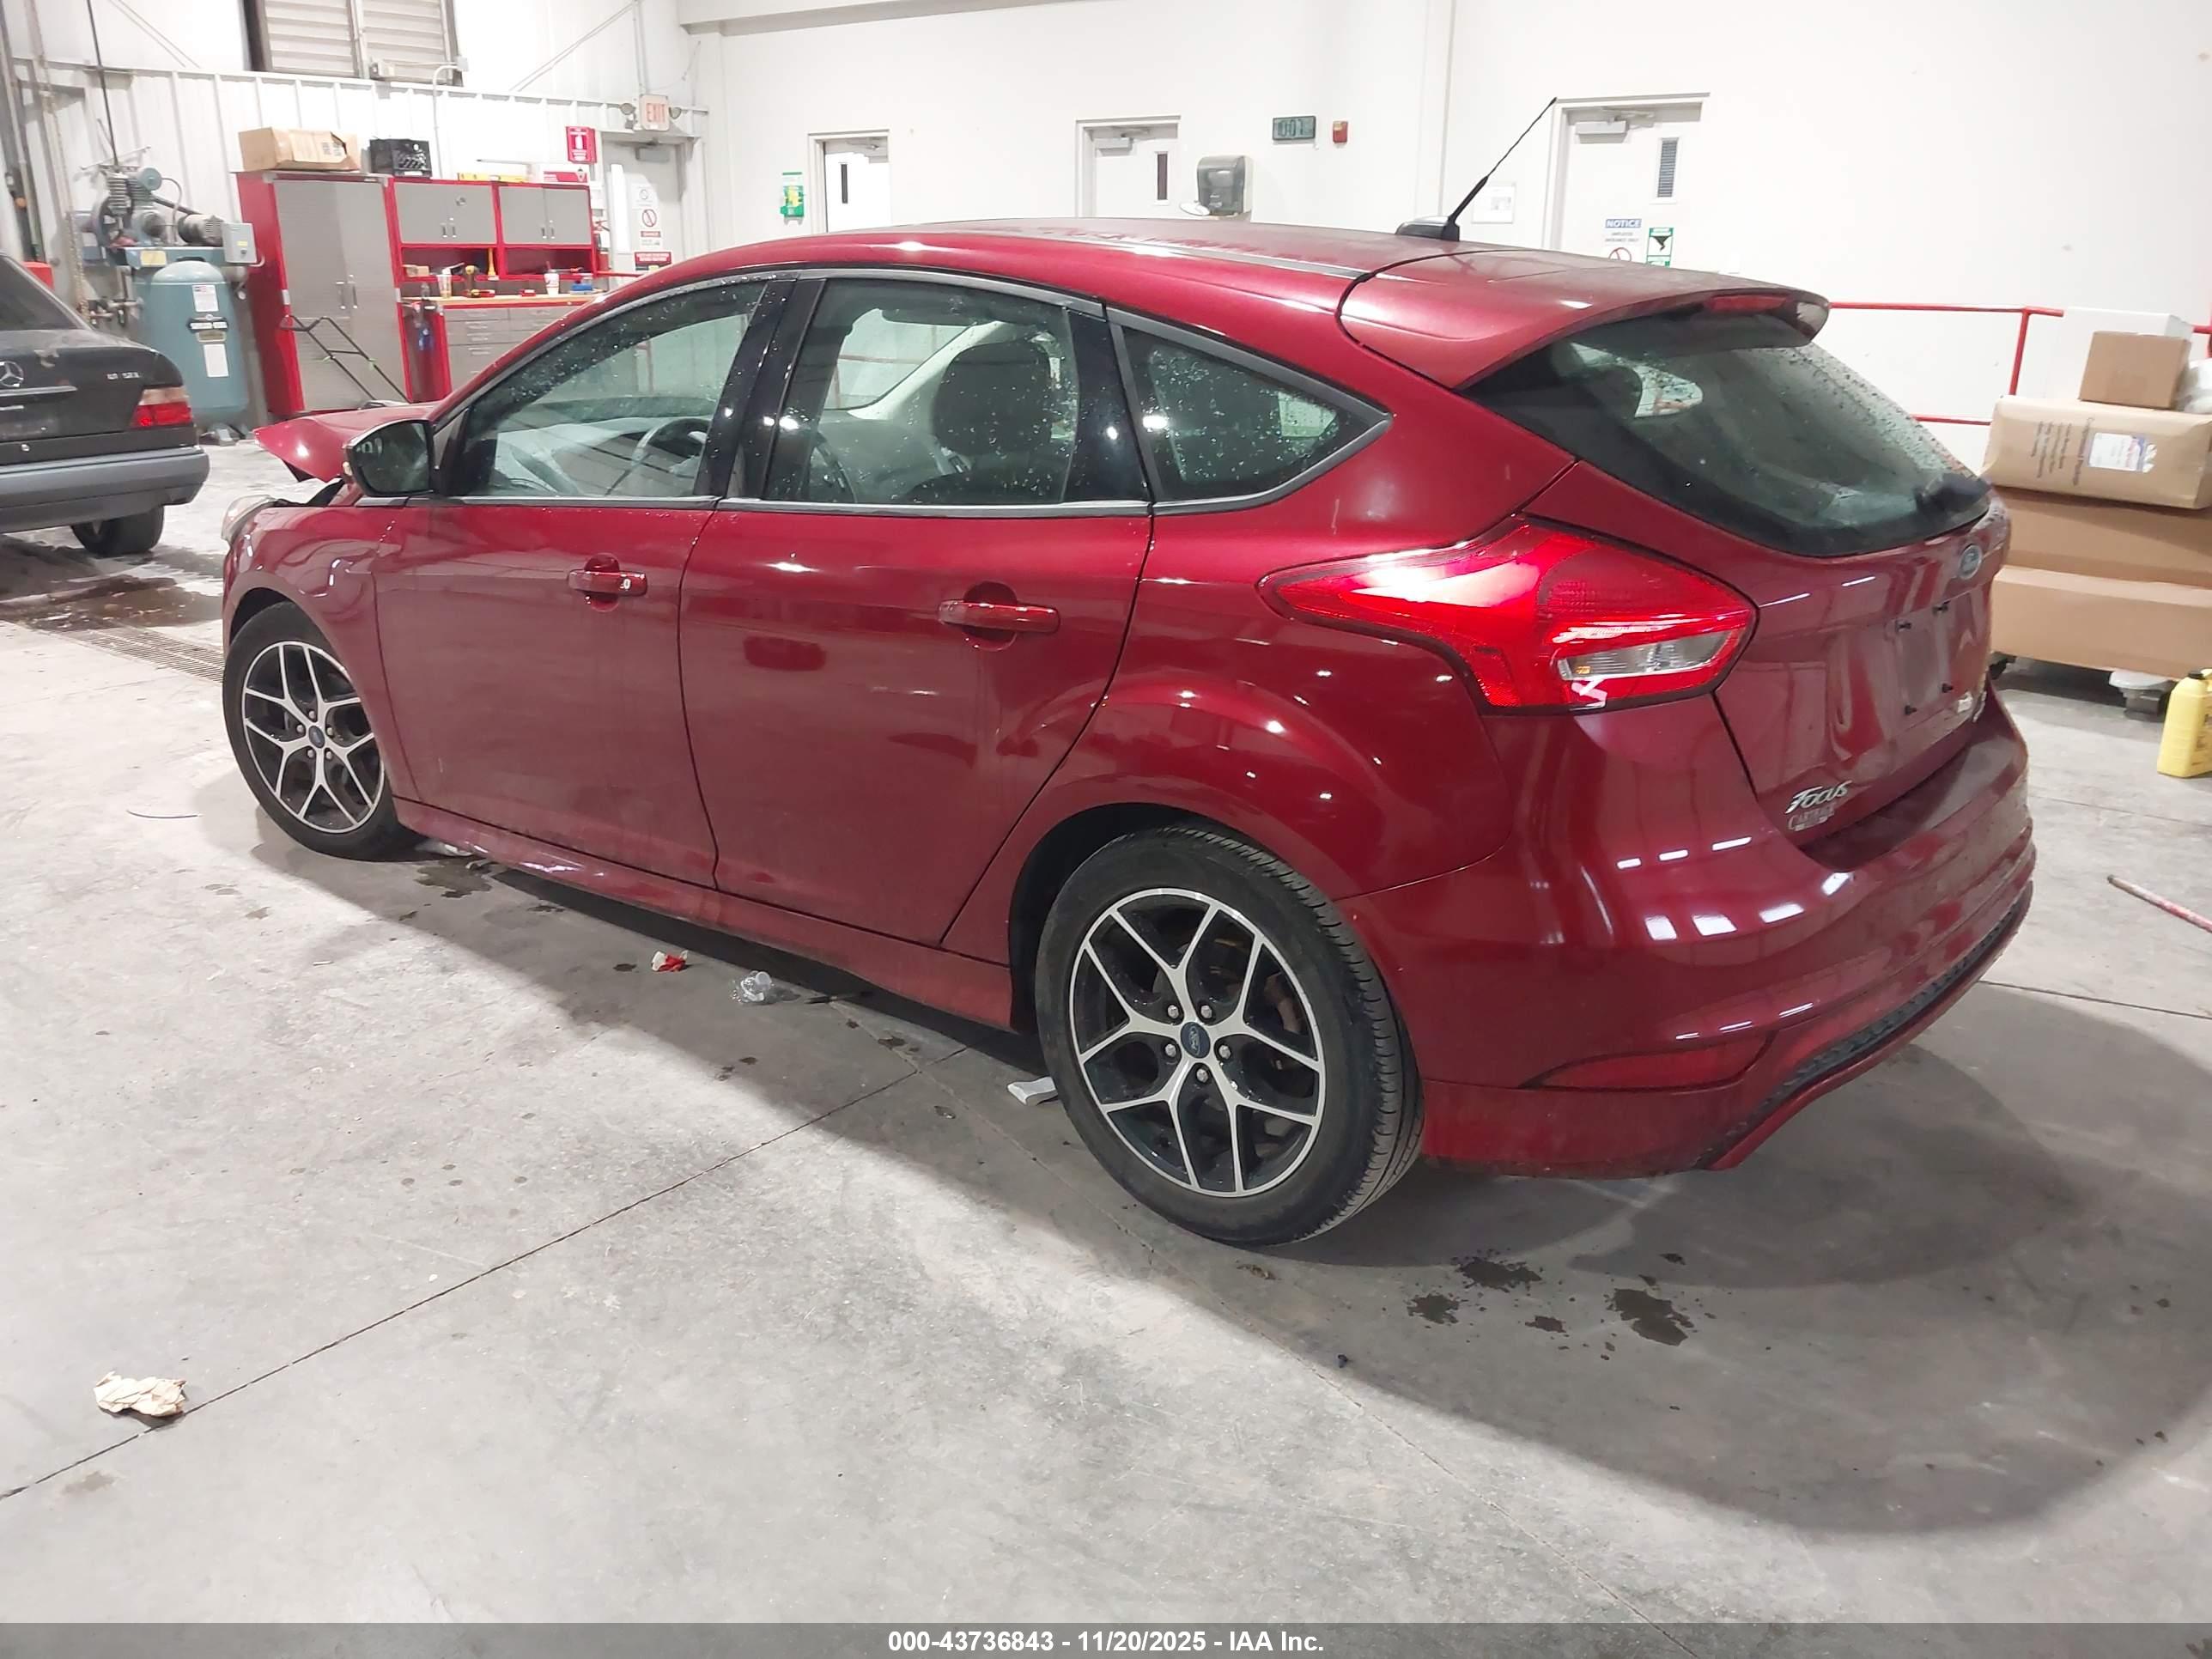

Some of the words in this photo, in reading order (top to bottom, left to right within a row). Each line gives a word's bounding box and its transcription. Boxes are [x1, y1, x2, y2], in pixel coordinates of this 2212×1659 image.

[646, 102, 666, 123] EXIT
[1607, 219, 1640, 228] NOTICE
[1785, 780, 1852, 814] Focus
